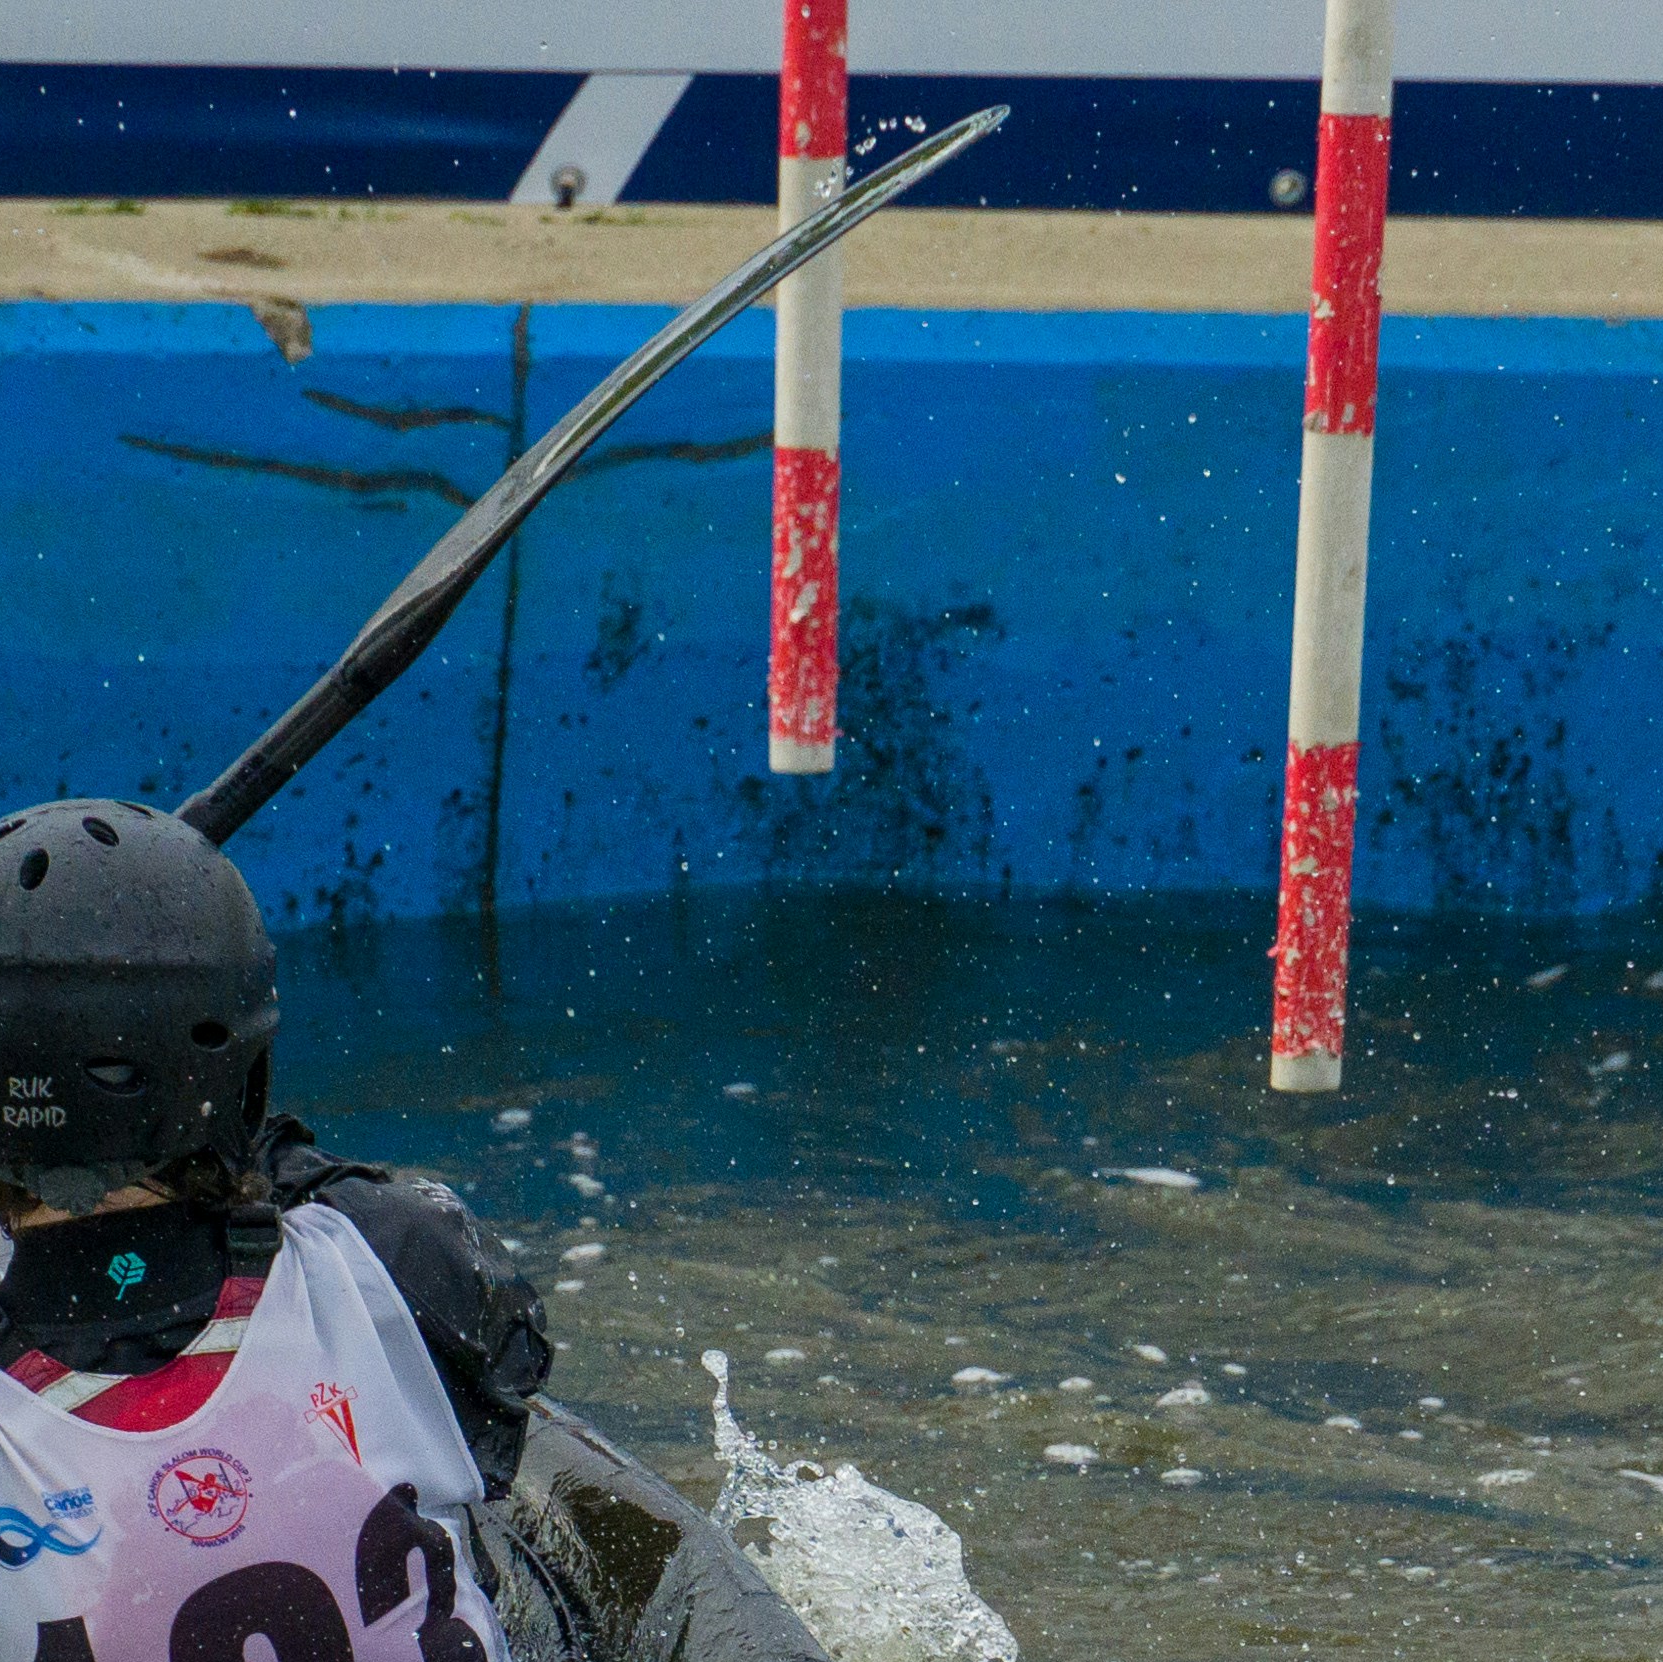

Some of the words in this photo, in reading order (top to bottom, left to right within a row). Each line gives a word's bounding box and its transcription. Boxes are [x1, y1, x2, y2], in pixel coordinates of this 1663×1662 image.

[8, 1076, 53, 1099] RUK
[3, 1105, 66, 1128] RAPID
[147, 1470, 163, 1501] CANOE
[161, 1449, 198, 1470] SLALOM
[199, 1447, 233, 1462] WORLD
[232, 1459, 249, 1476] CUP
[43, 1493, 95, 1511] canoe
